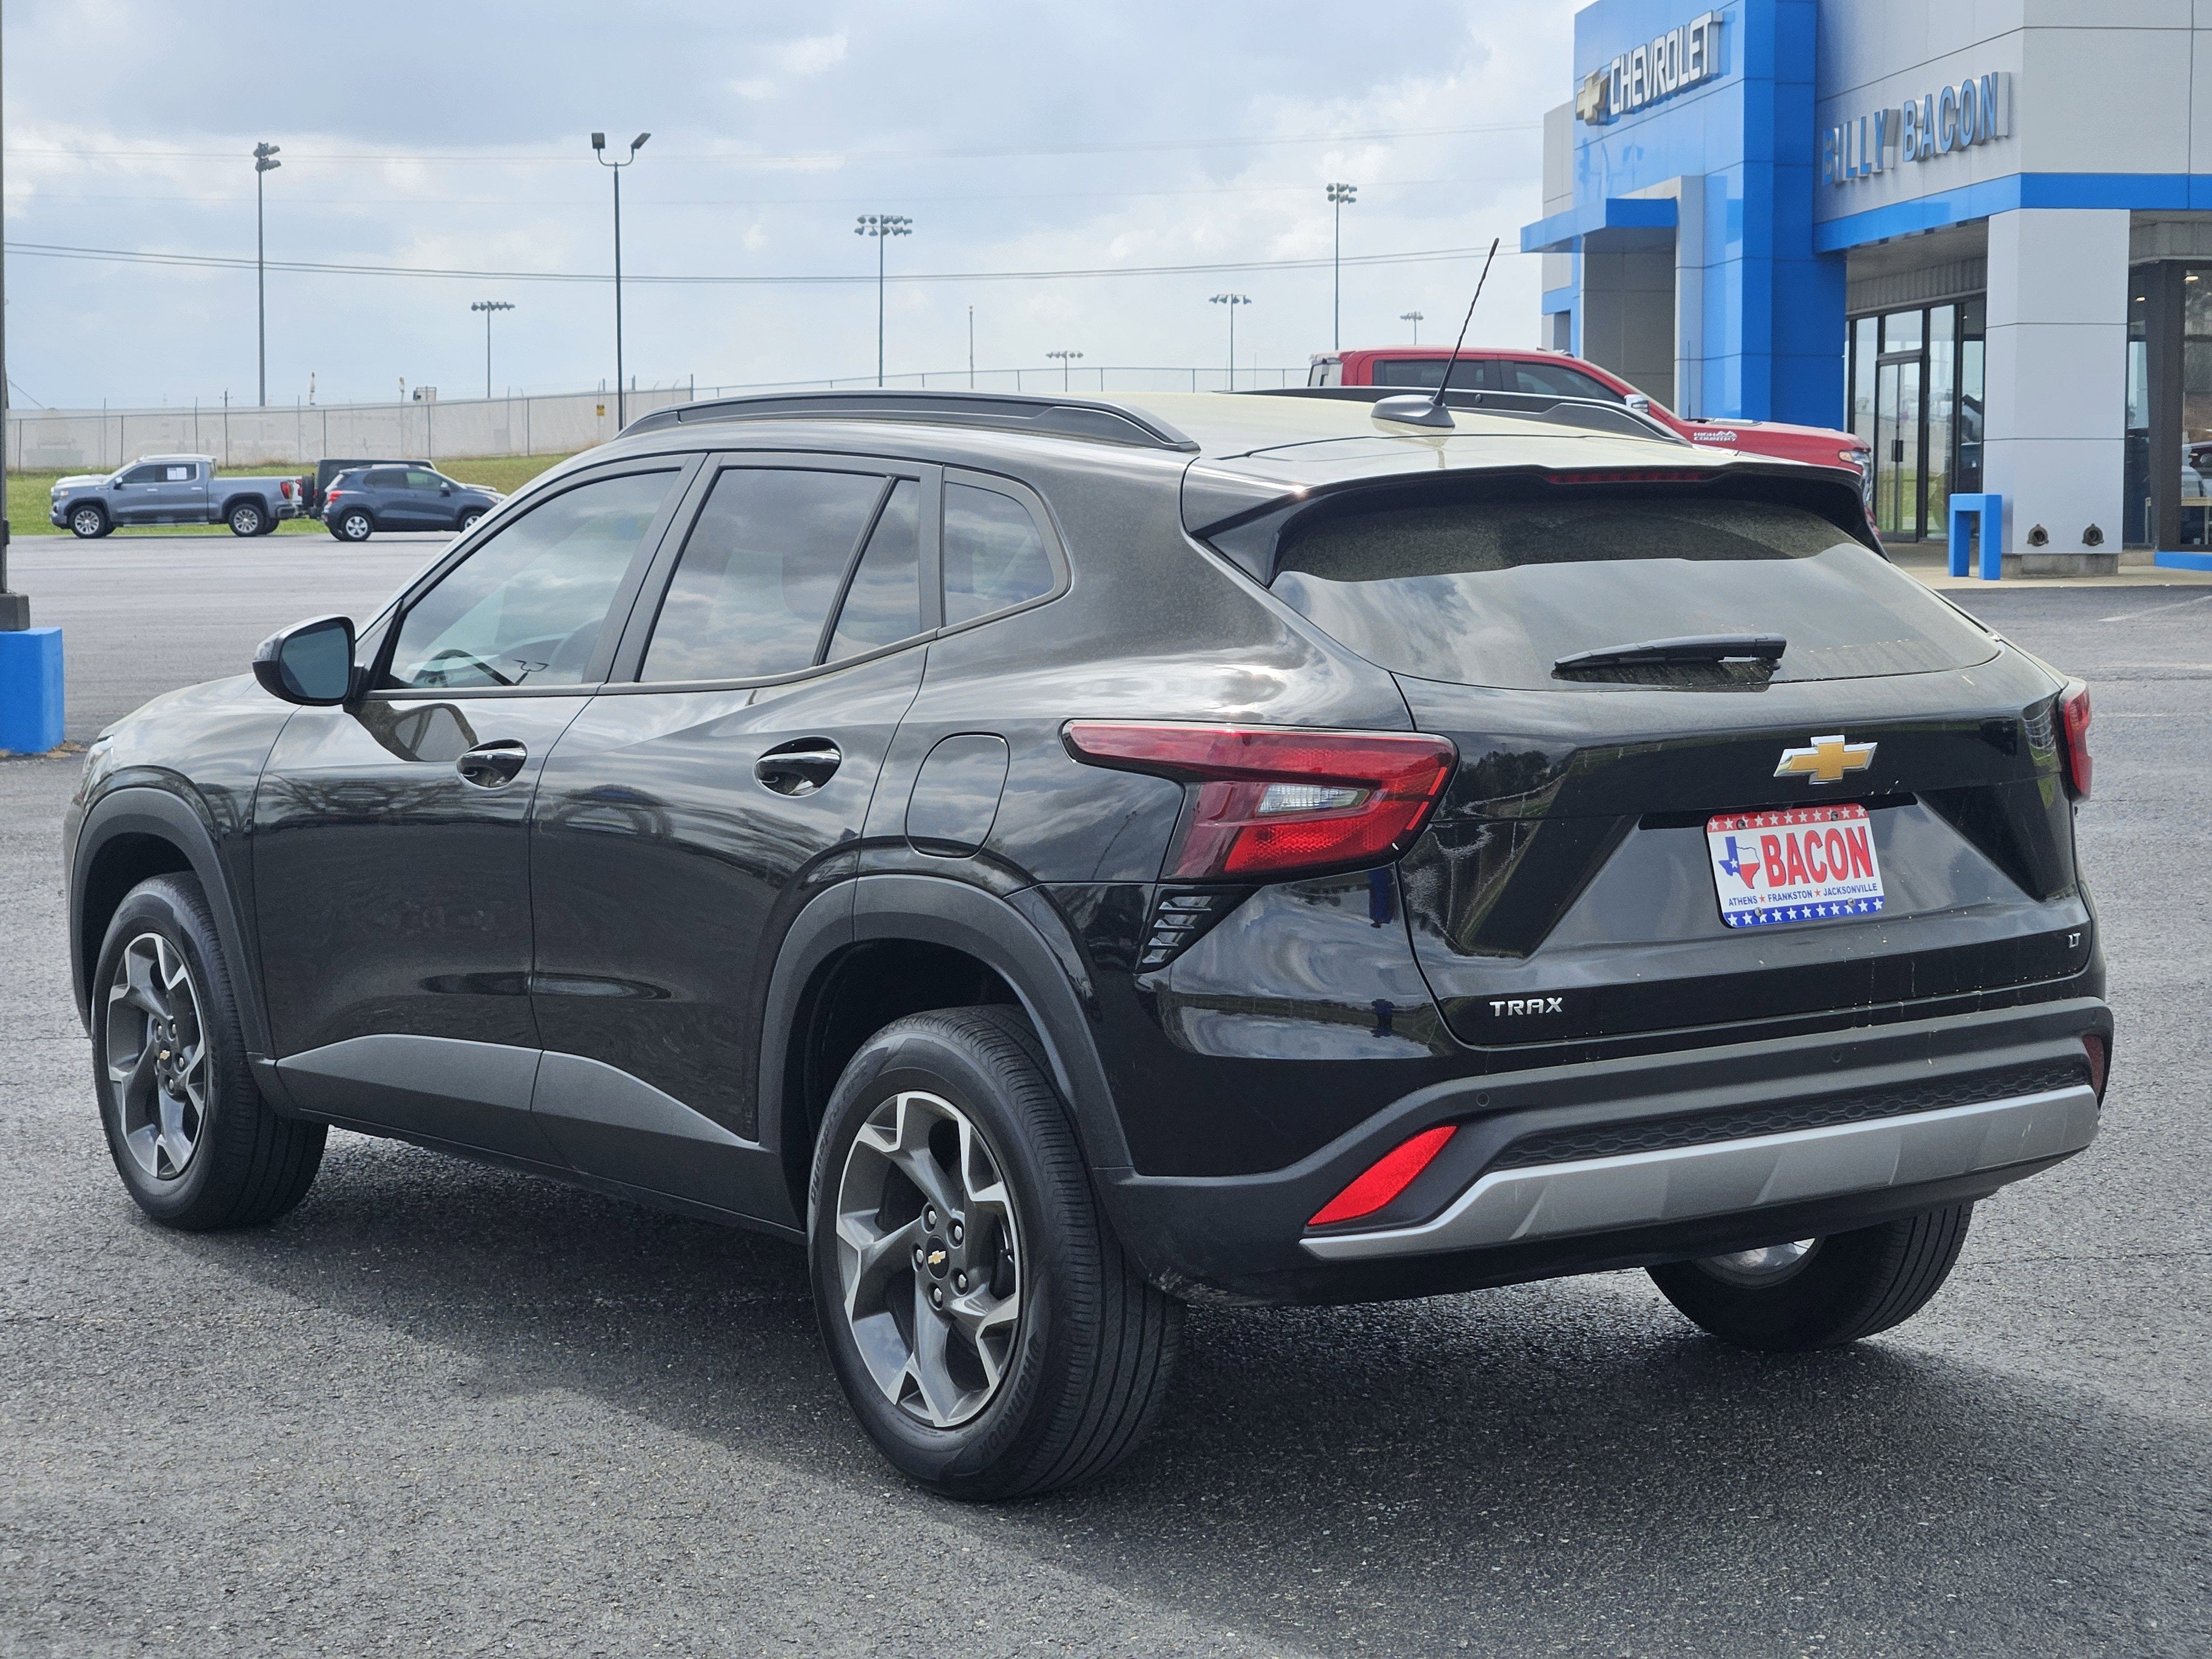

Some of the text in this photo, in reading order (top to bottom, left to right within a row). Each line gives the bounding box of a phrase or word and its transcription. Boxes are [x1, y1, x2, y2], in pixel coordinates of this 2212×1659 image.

[1610, 10, 1713, 116] CHEVROLET
[1824, 71, 1998, 185] BILLY BACON
[1760, 826, 1874, 888] BACON
[1729, 883, 1877, 906] ATHENS FRANKSTON JACKSONVILLE
[1489, 997, 1563, 1016] TRAX
